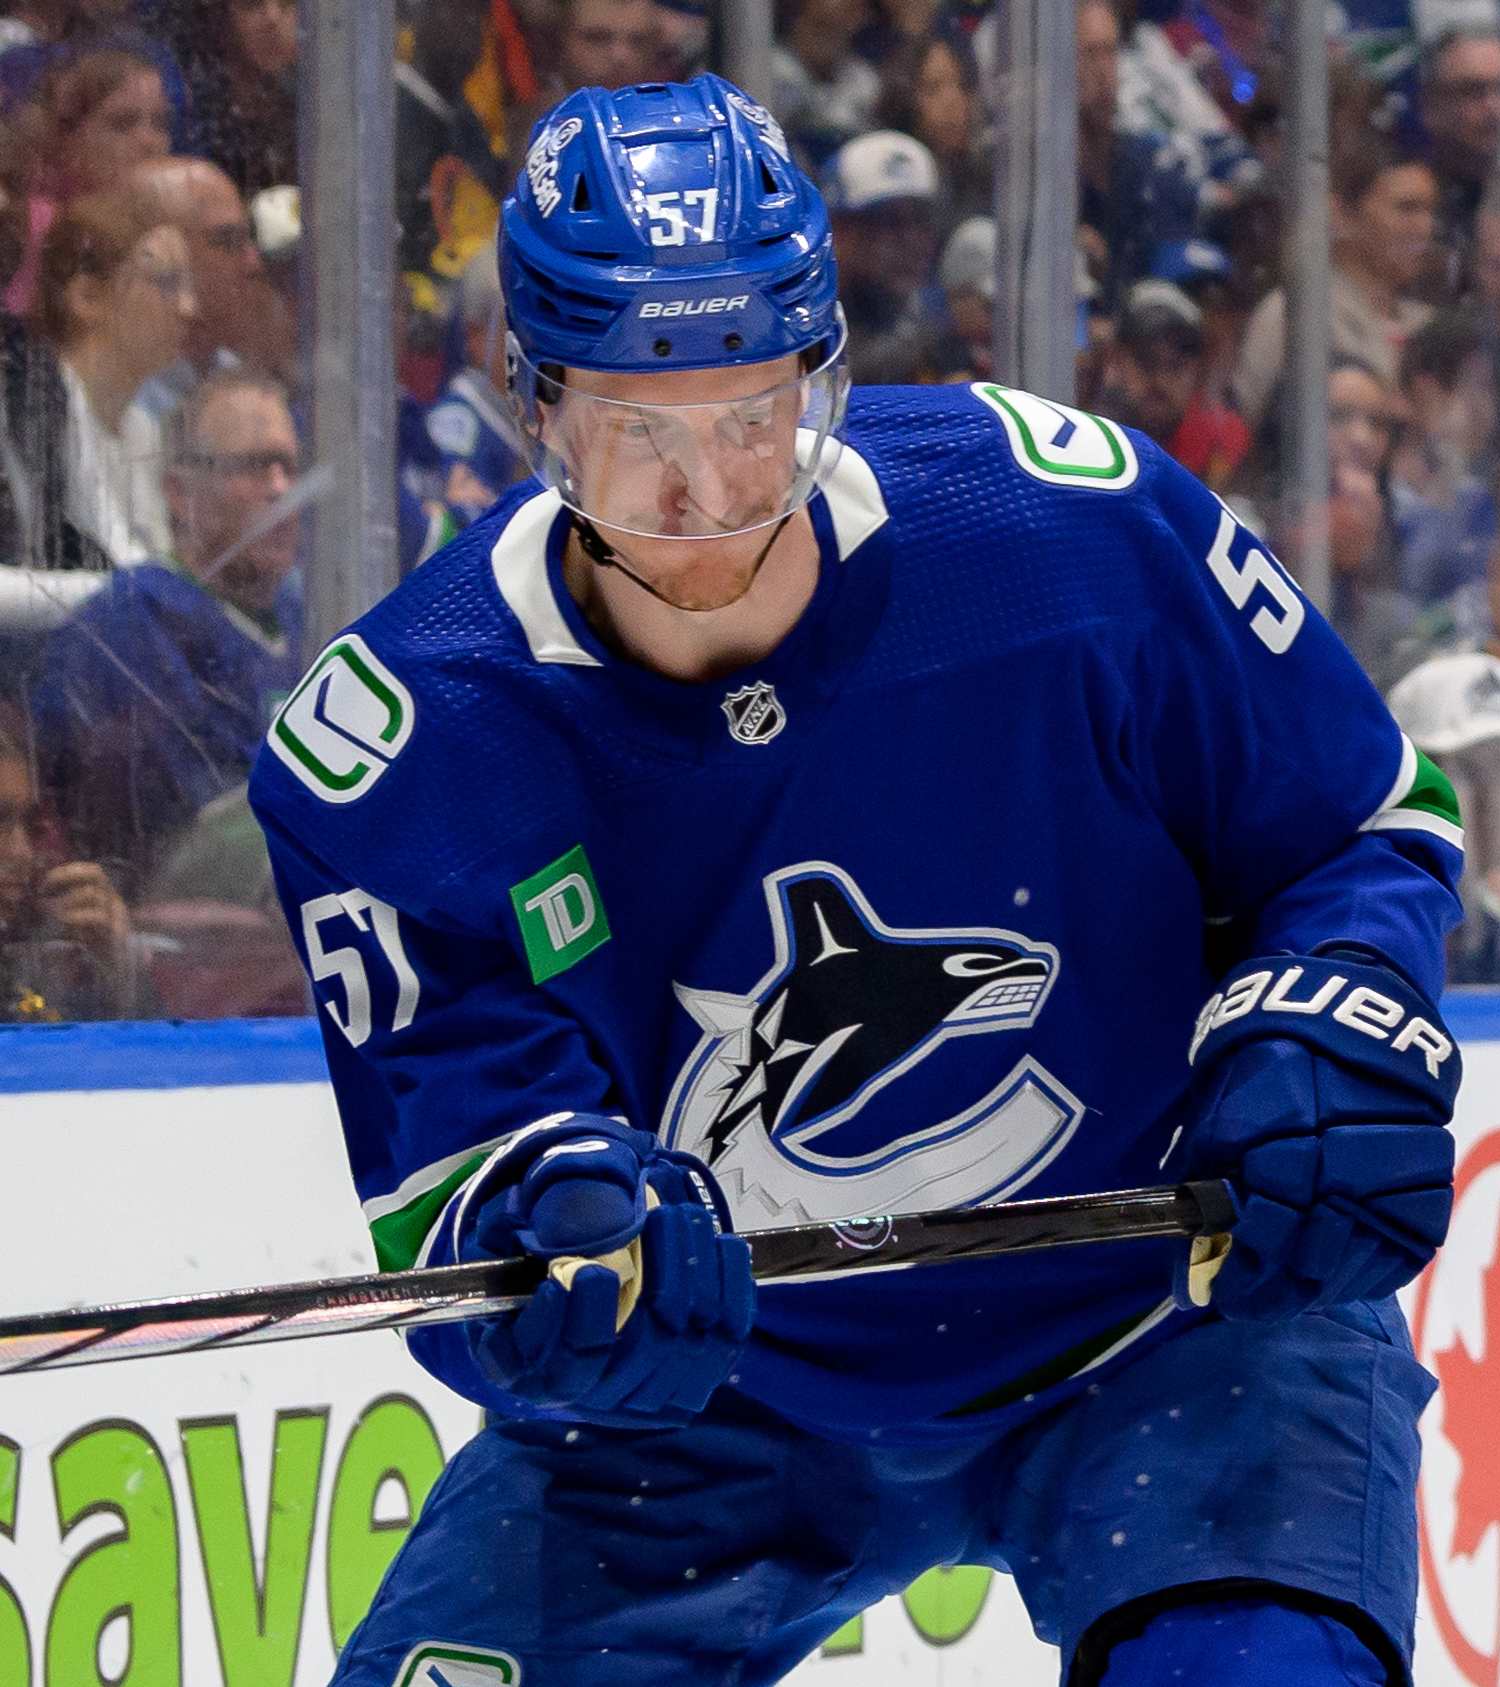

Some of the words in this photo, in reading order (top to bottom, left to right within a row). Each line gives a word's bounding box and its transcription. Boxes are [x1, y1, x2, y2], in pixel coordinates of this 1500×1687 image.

[643, 188, 718, 247] 57
[639, 294, 750, 319] BAUER
[1206, 491, 1305, 655] 5
[524, 873, 596, 952] TD
[300, 888, 421, 1049] 57
